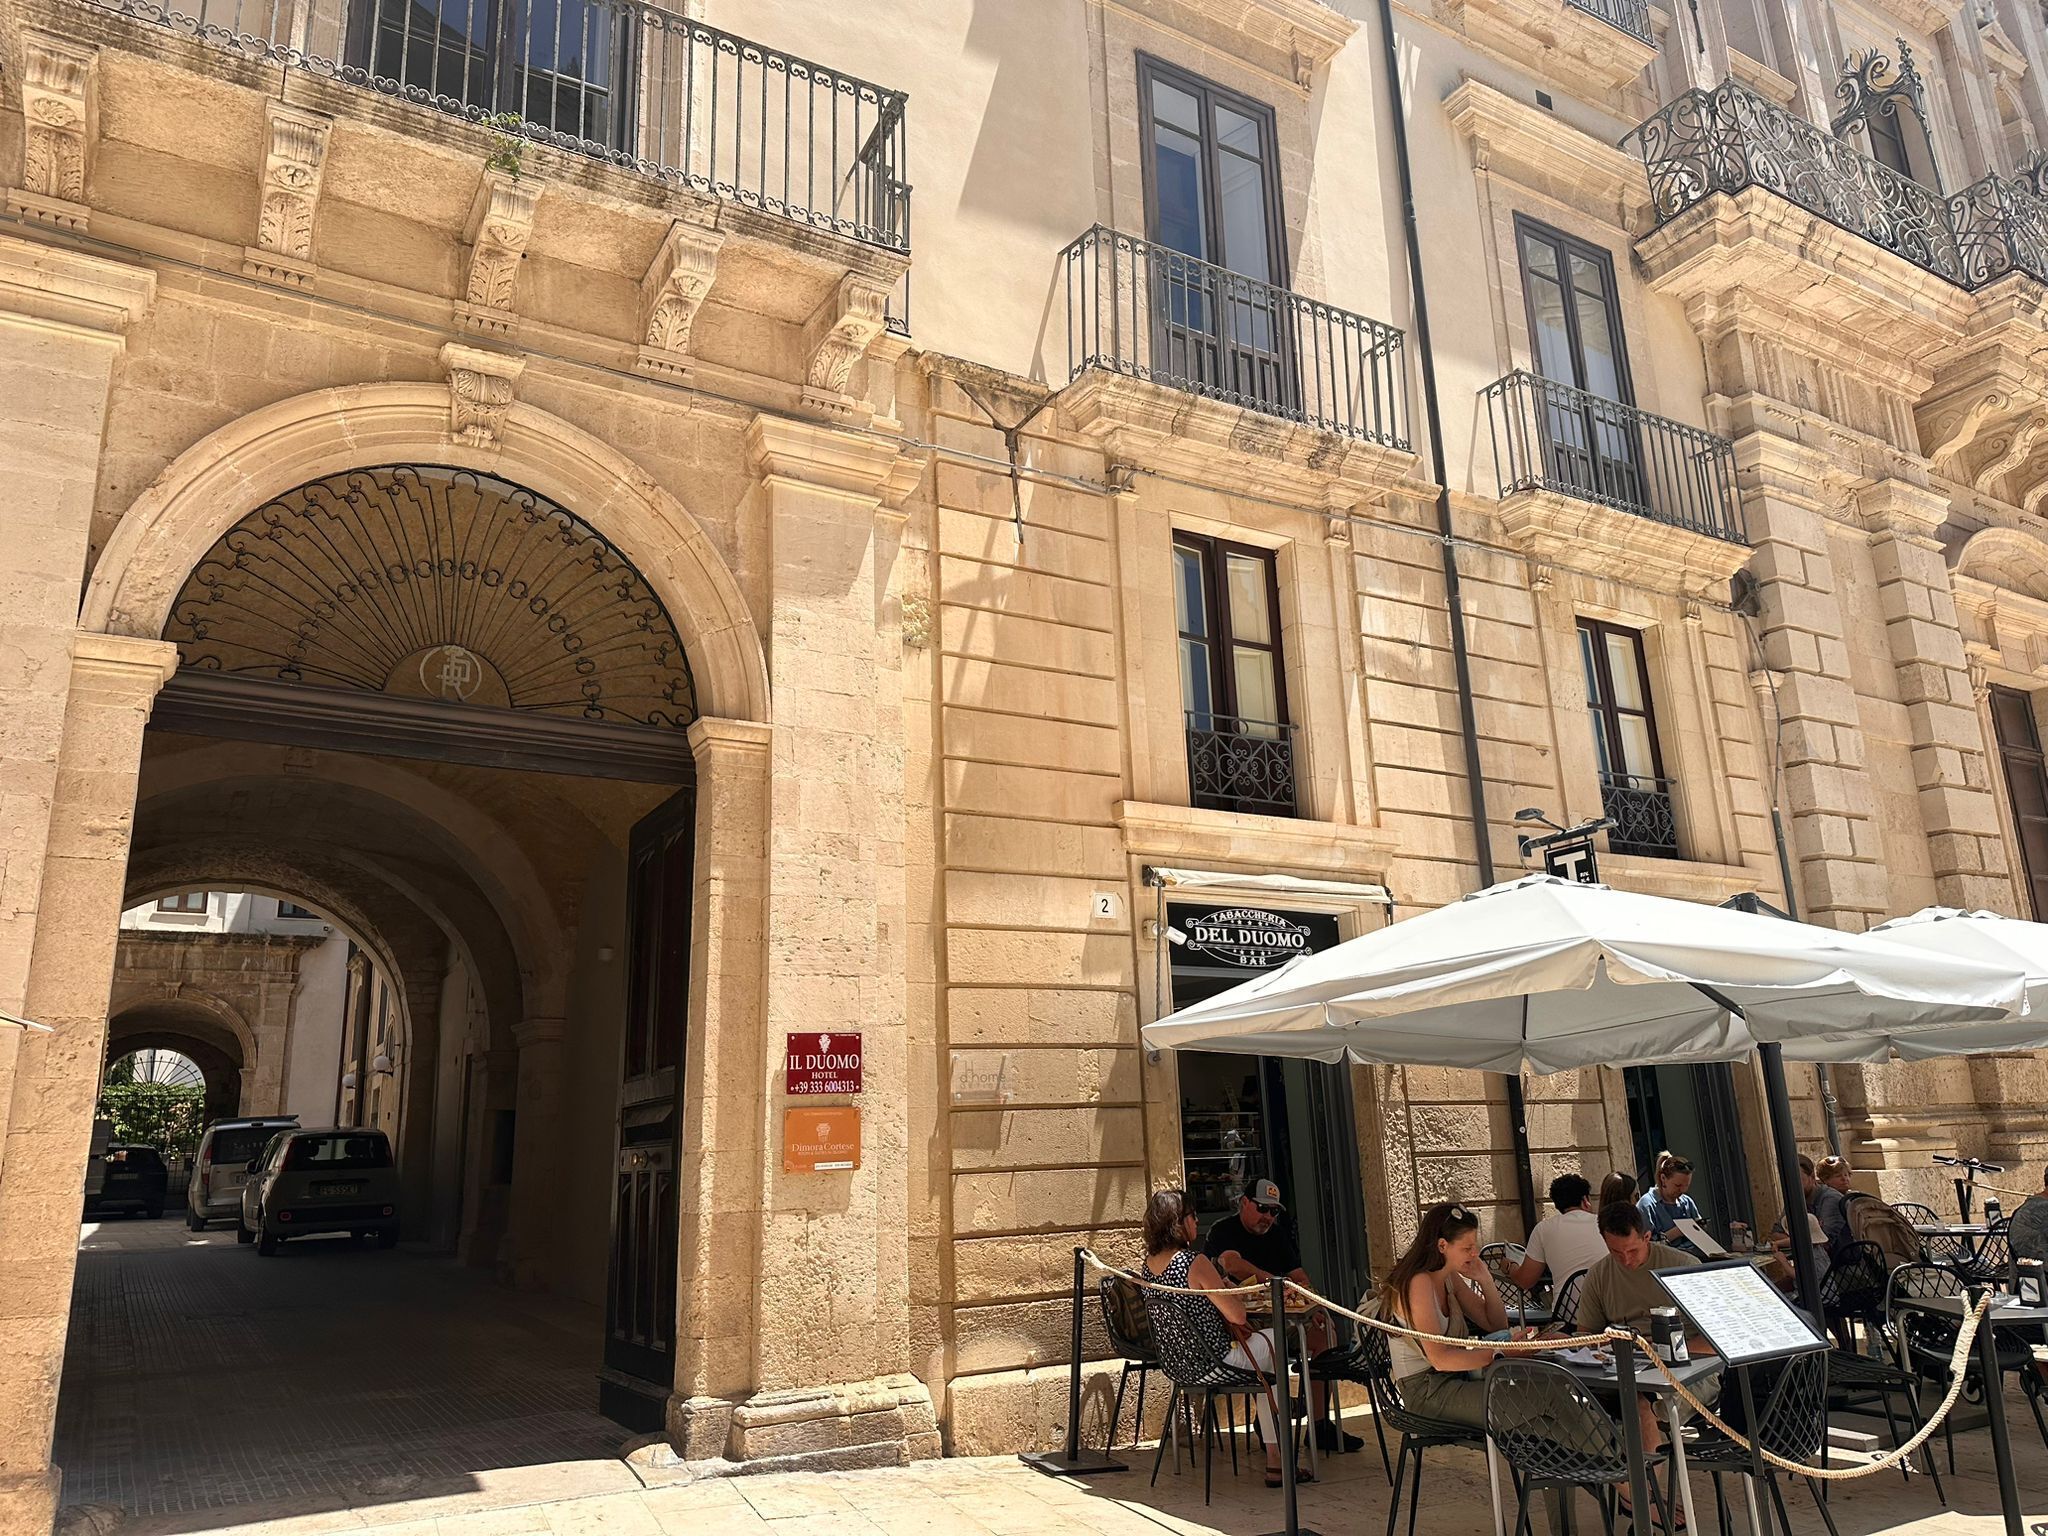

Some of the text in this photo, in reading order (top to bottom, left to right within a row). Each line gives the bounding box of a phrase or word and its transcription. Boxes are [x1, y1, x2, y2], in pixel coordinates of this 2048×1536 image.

[1101, 898, 1109, 913] 2
[1211, 909, 1286, 928] TABACCHERIA
[1194, 926, 1305, 948] DEL DUOMO
[1240, 956, 1266, 965] BAR
[789, 1053, 860, 1070] IL DUOMO
[811, 1071, 838, 1079] HOTEL
[794, 1080, 855, 1093] +39 333 6004313
